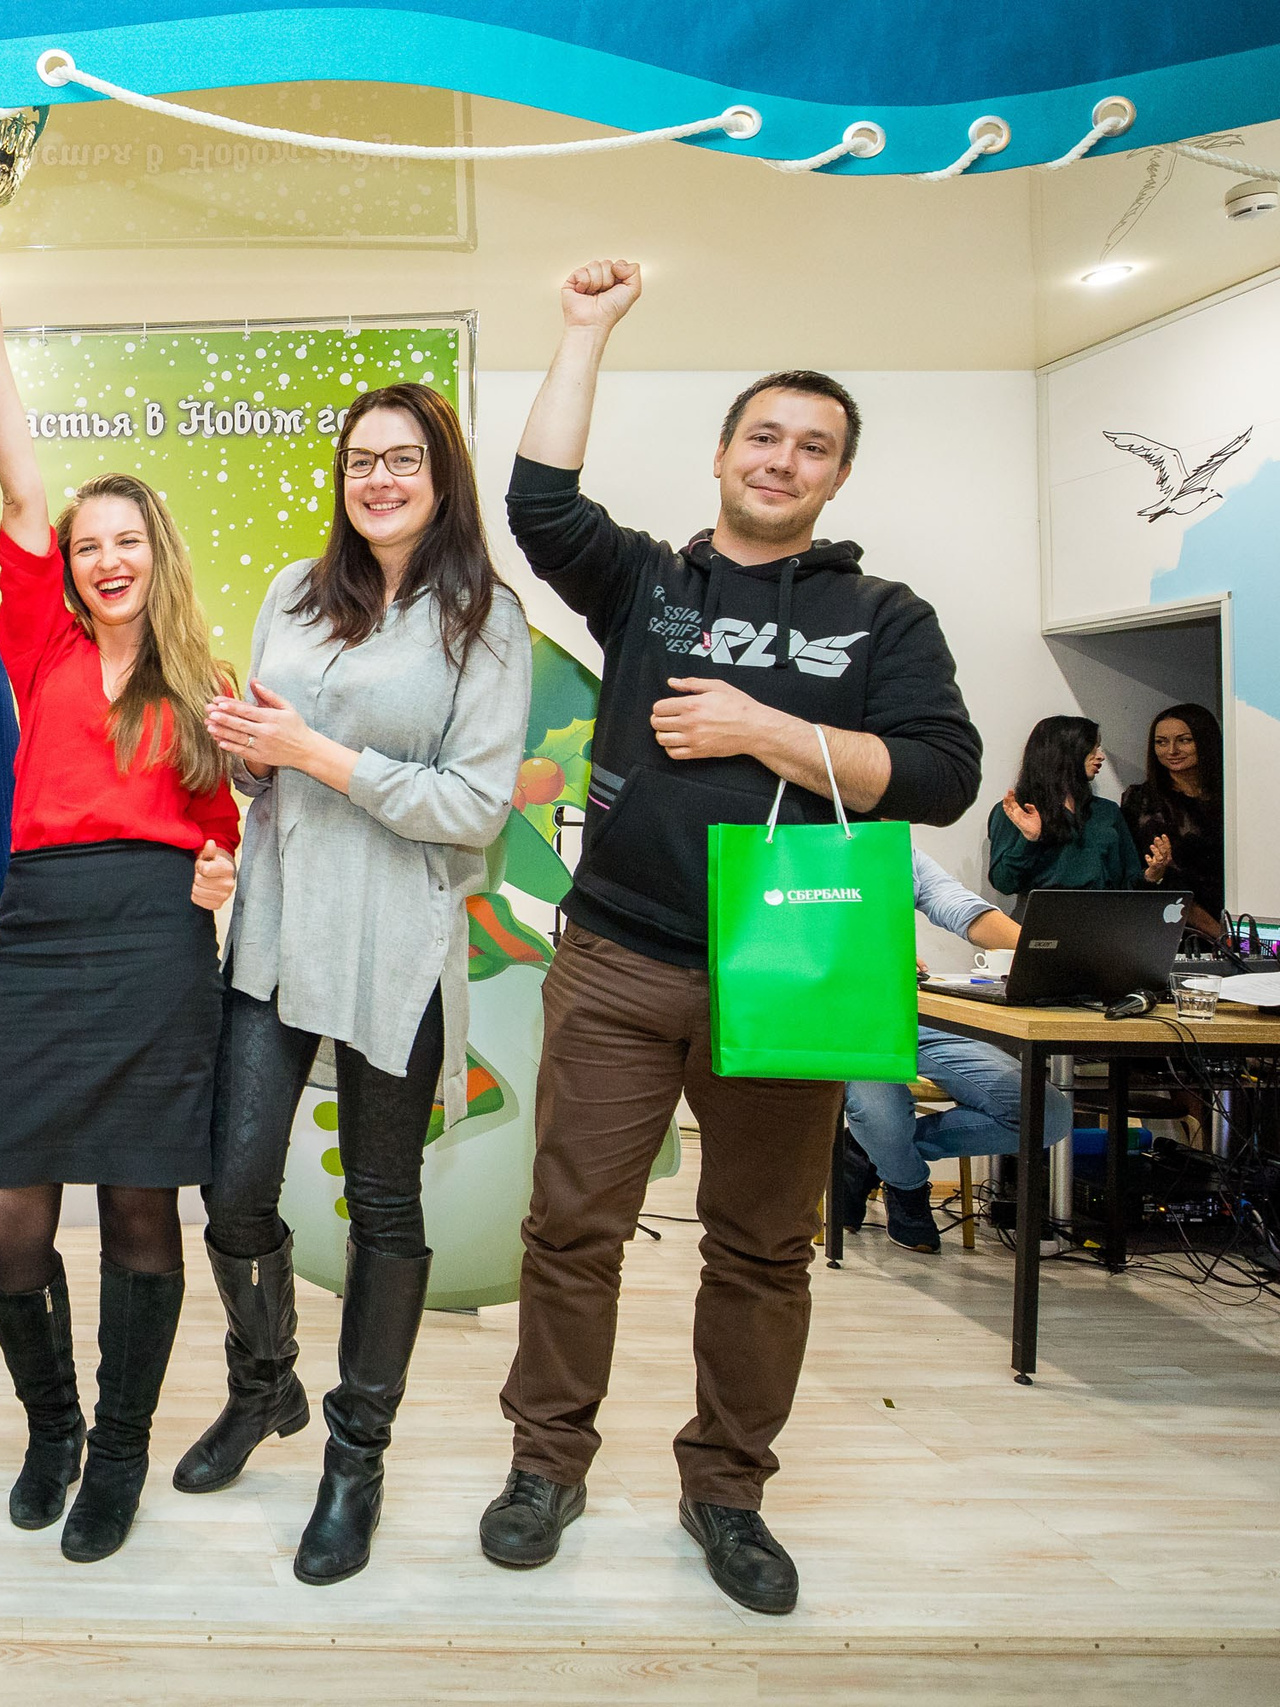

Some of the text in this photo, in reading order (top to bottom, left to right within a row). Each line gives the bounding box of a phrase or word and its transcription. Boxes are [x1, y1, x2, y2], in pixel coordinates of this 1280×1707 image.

[146, 402, 164, 436] в
[178, 400, 303, 435] Новом
[787, 888, 862, 901] СБЕРБАНК
